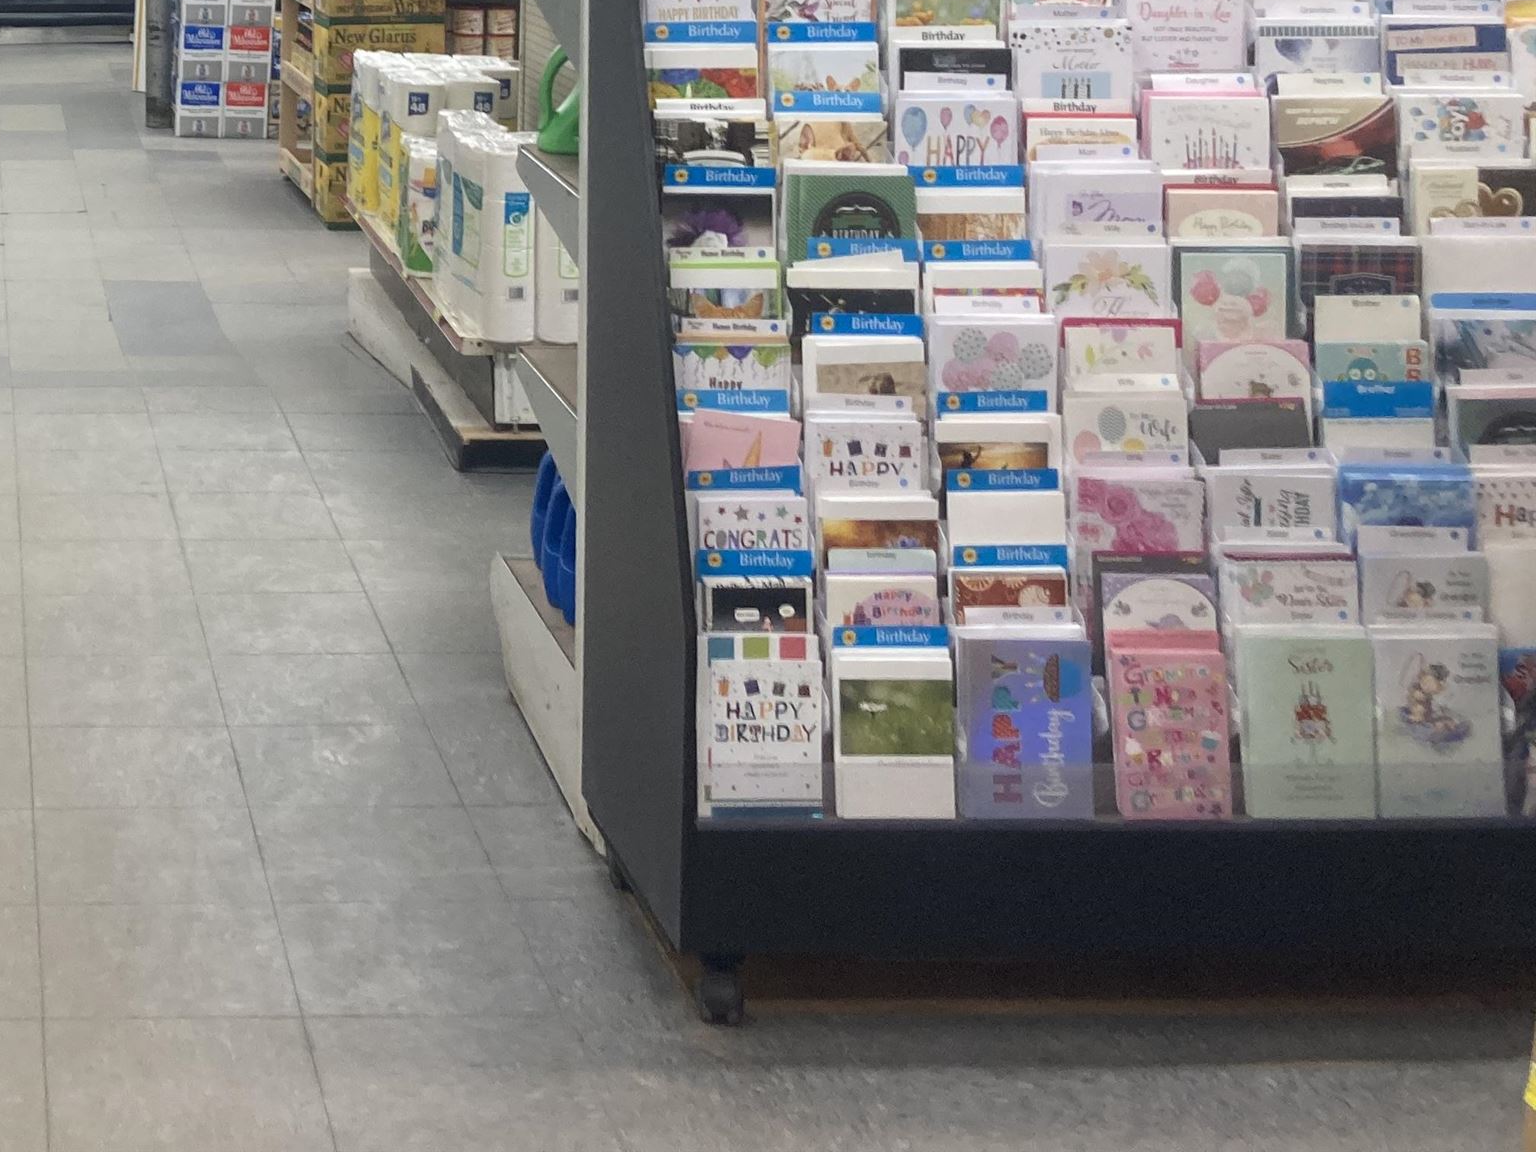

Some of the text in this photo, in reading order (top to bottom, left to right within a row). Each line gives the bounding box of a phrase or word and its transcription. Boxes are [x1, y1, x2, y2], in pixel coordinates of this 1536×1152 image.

[333, 28, 416, 45] New Glarus
[688, 24, 742, 39] Birthday
[806, 24, 859, 40] Birthday
[921, 30, 966, 43] Birthday
[937, 76, 968, 87] Birthday
[333, 97, 351, 113] Ne
[689, 102, 735, 112] Birthday
[813, 93, 864, 108] Birthday
[1052, 101, 1097, 114] Birthday
[925, 135, 990, 167] HAPPY
[705, 169, 759, 185] Birthday
[955, 168, 1008, 182] Birthday
[1193, 174, 1240, 186] Birthday
[962, 243, 1013, 258] Birthday
[971, 300, 1003, 310] Birthday
[851, 316, 905, 332] Birthday
[717, 392, 772, 409] Birthday
[844, 398, 876, 408] Birthday
[976, 394, 1029, 410] Birthday
[829, 460, 905, 477] HAPPY
[729, 469, 783, 485] Birthday
[848, 479, 880, 489] Birthday
[988, 472, 1042, 487] Birthday
[703, 528, 803, 550] CONGRATS
[738, 554, 796, 570] Birthday
[996, 547, 1051, 563] Birthday
[1001, 611, 1034, 622] Birthday
[875, 628, 931, 644] Birthday
[726, 701, 803, 721] HAPPY
[714, 723, 817, 744] BIRTHDAY
[990, 654, 1023, 804] HAPPY
[1032, 708, 1076, 808] Birthday
